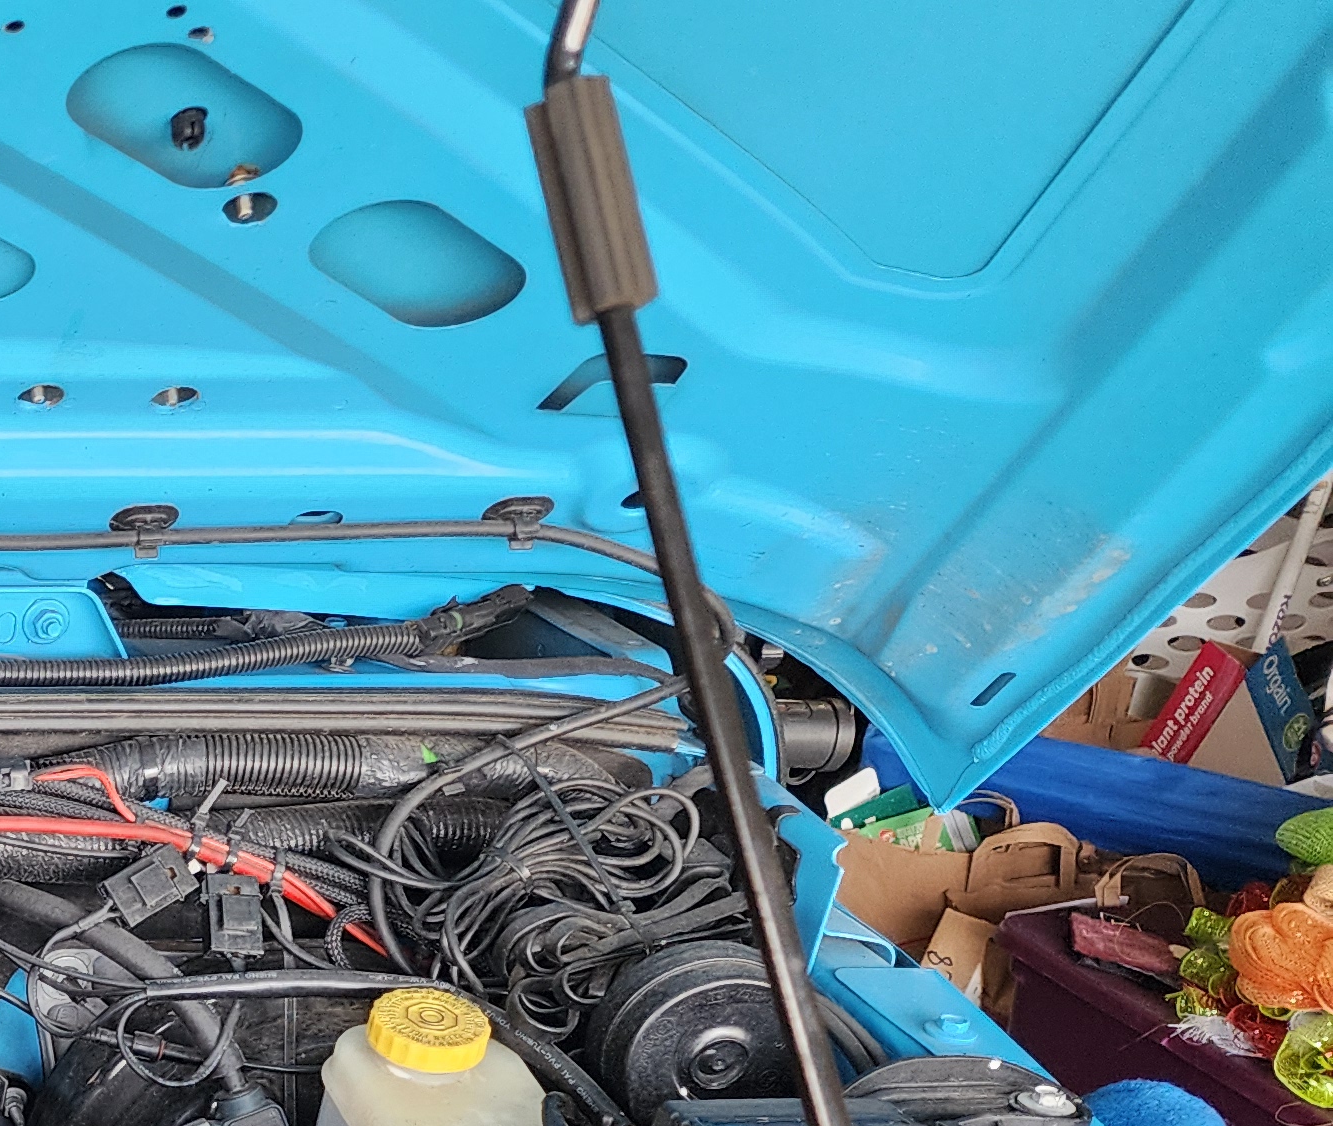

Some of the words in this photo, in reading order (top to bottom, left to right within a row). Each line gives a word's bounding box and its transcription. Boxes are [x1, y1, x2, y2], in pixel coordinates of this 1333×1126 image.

[1151, 718, 1180, 756] lant
[1173, 665, 1216, 726] protein
[1262, 654, 1293, 716] Orgain
[1165, 724, 1195, 762] powder
[1189, 692, 1215, 726] brand
